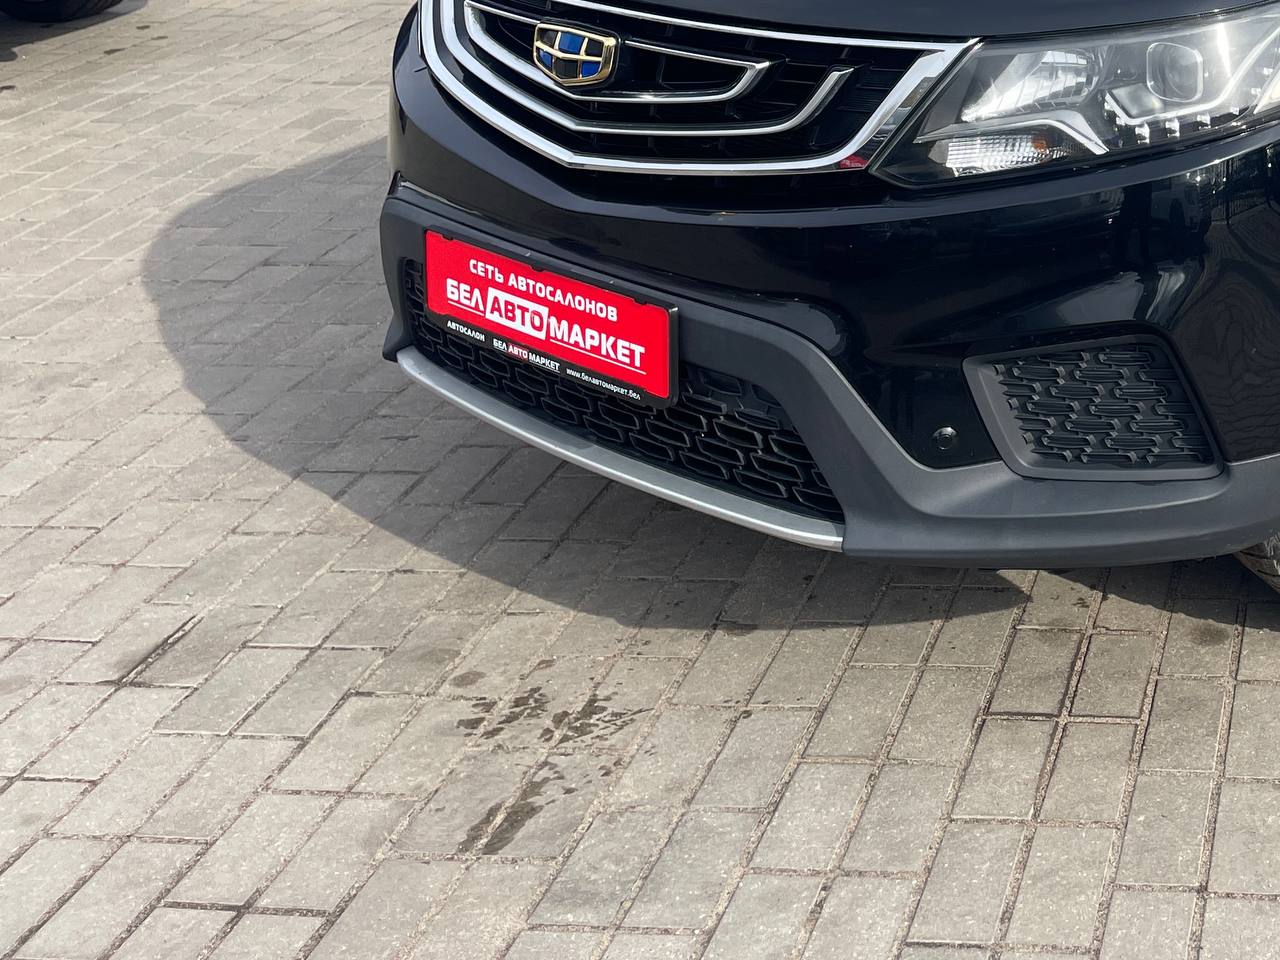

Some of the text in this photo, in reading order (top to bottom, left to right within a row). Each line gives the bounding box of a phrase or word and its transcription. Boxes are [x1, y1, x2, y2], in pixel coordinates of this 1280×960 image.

[469, 258, 618, 322] СЕТЬ АВТОСАЛОНОВ
[446, 278, 646, 368] БЕЛ АВТО МАРКЕТ
[447, 320, 485, 342] АВТОСАЛОН
[493, 338, 508, 352] БЕЛ
[508, 343, 528, 360] АВТО
[529, 352, 560, 372] МАРКЕТ
